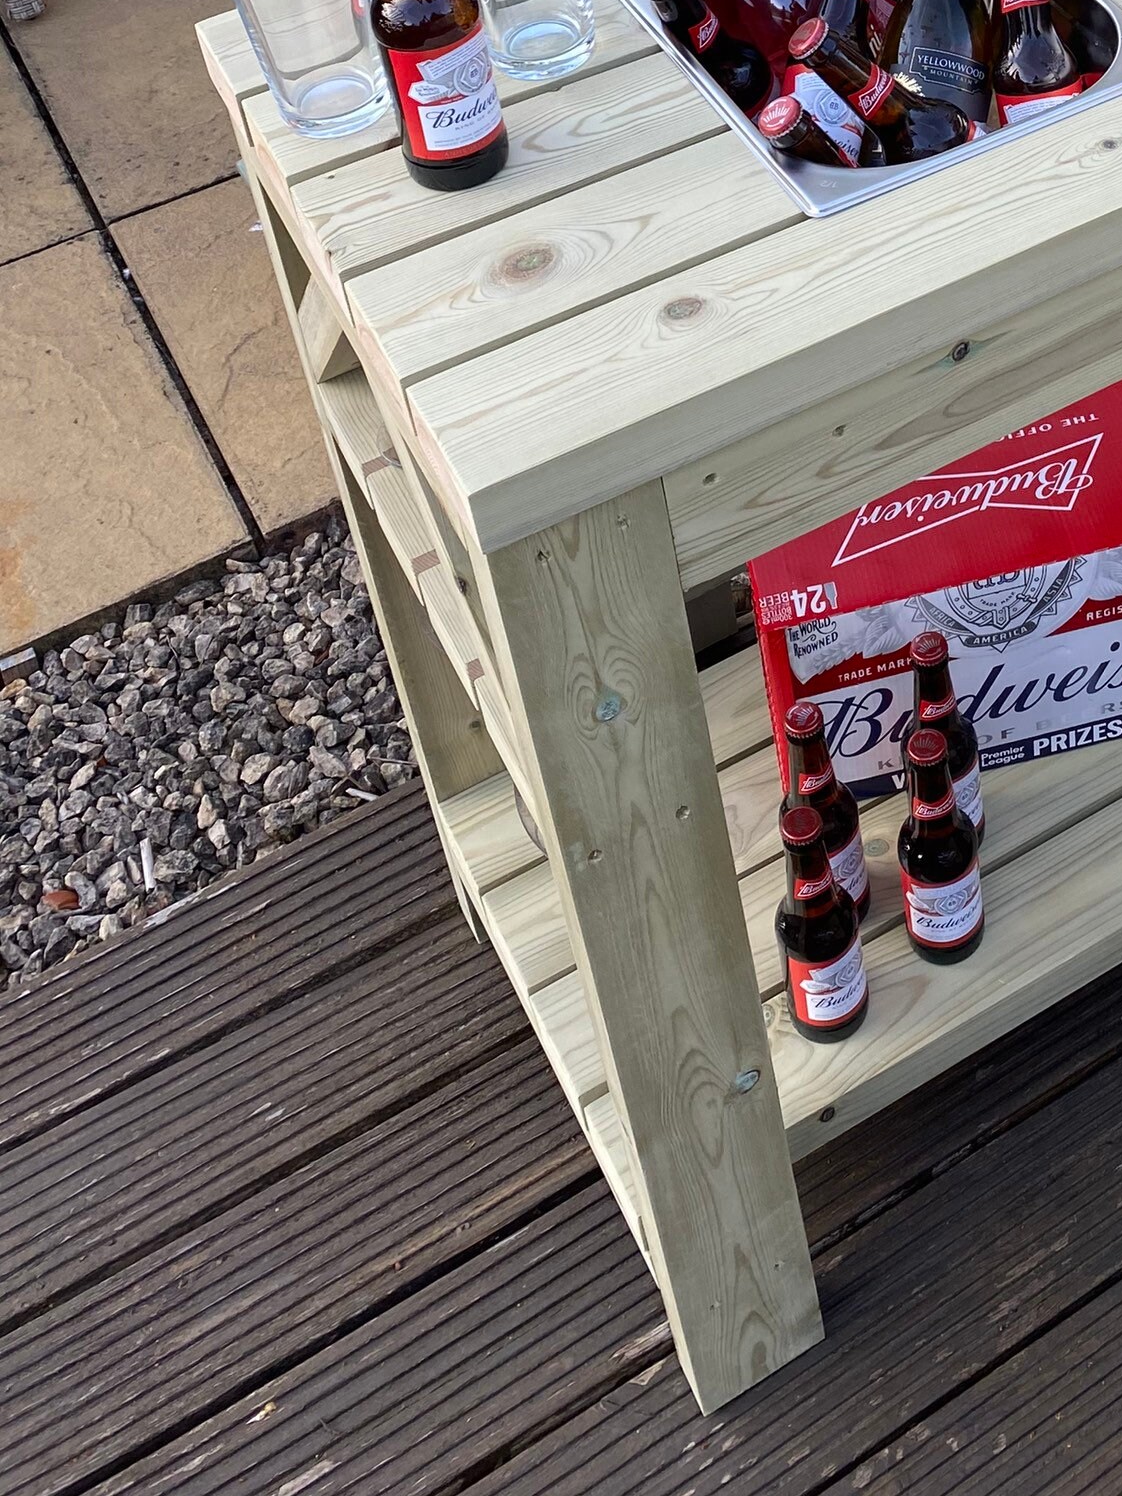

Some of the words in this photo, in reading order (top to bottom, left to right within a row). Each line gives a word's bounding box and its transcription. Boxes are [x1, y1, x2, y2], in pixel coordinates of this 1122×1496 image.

[917, 54, 986, 81] YELLOWWOOD
[929, 68, 973, 86] MOUNTAIN
[834, 138, 860, 158] eiser
[1059, 412, 1100, 428] THE
[856, 457, 1094, 527] Budweiser
[758, 591, 790, 608] BEER
[1043, 577, 1064, 603] ASIA
[789, 583, 827, 618] 24
[979, 598, 998, 607] TRADE
[761, 606, 792, 620] BOTTLES
[928, 607, 956, 628] AFRICA
[787, 627, 801, 643] THE
[798, 616, 837, 637] WORLD
[972, 625, 1029, 646] AMERICA
[792, 631, 839, 660] RENOWNED
[837, 666, 873, 683] TRADE
[981, 745, 1025, 761] Premier
[981, 752, 1026, 768] League
